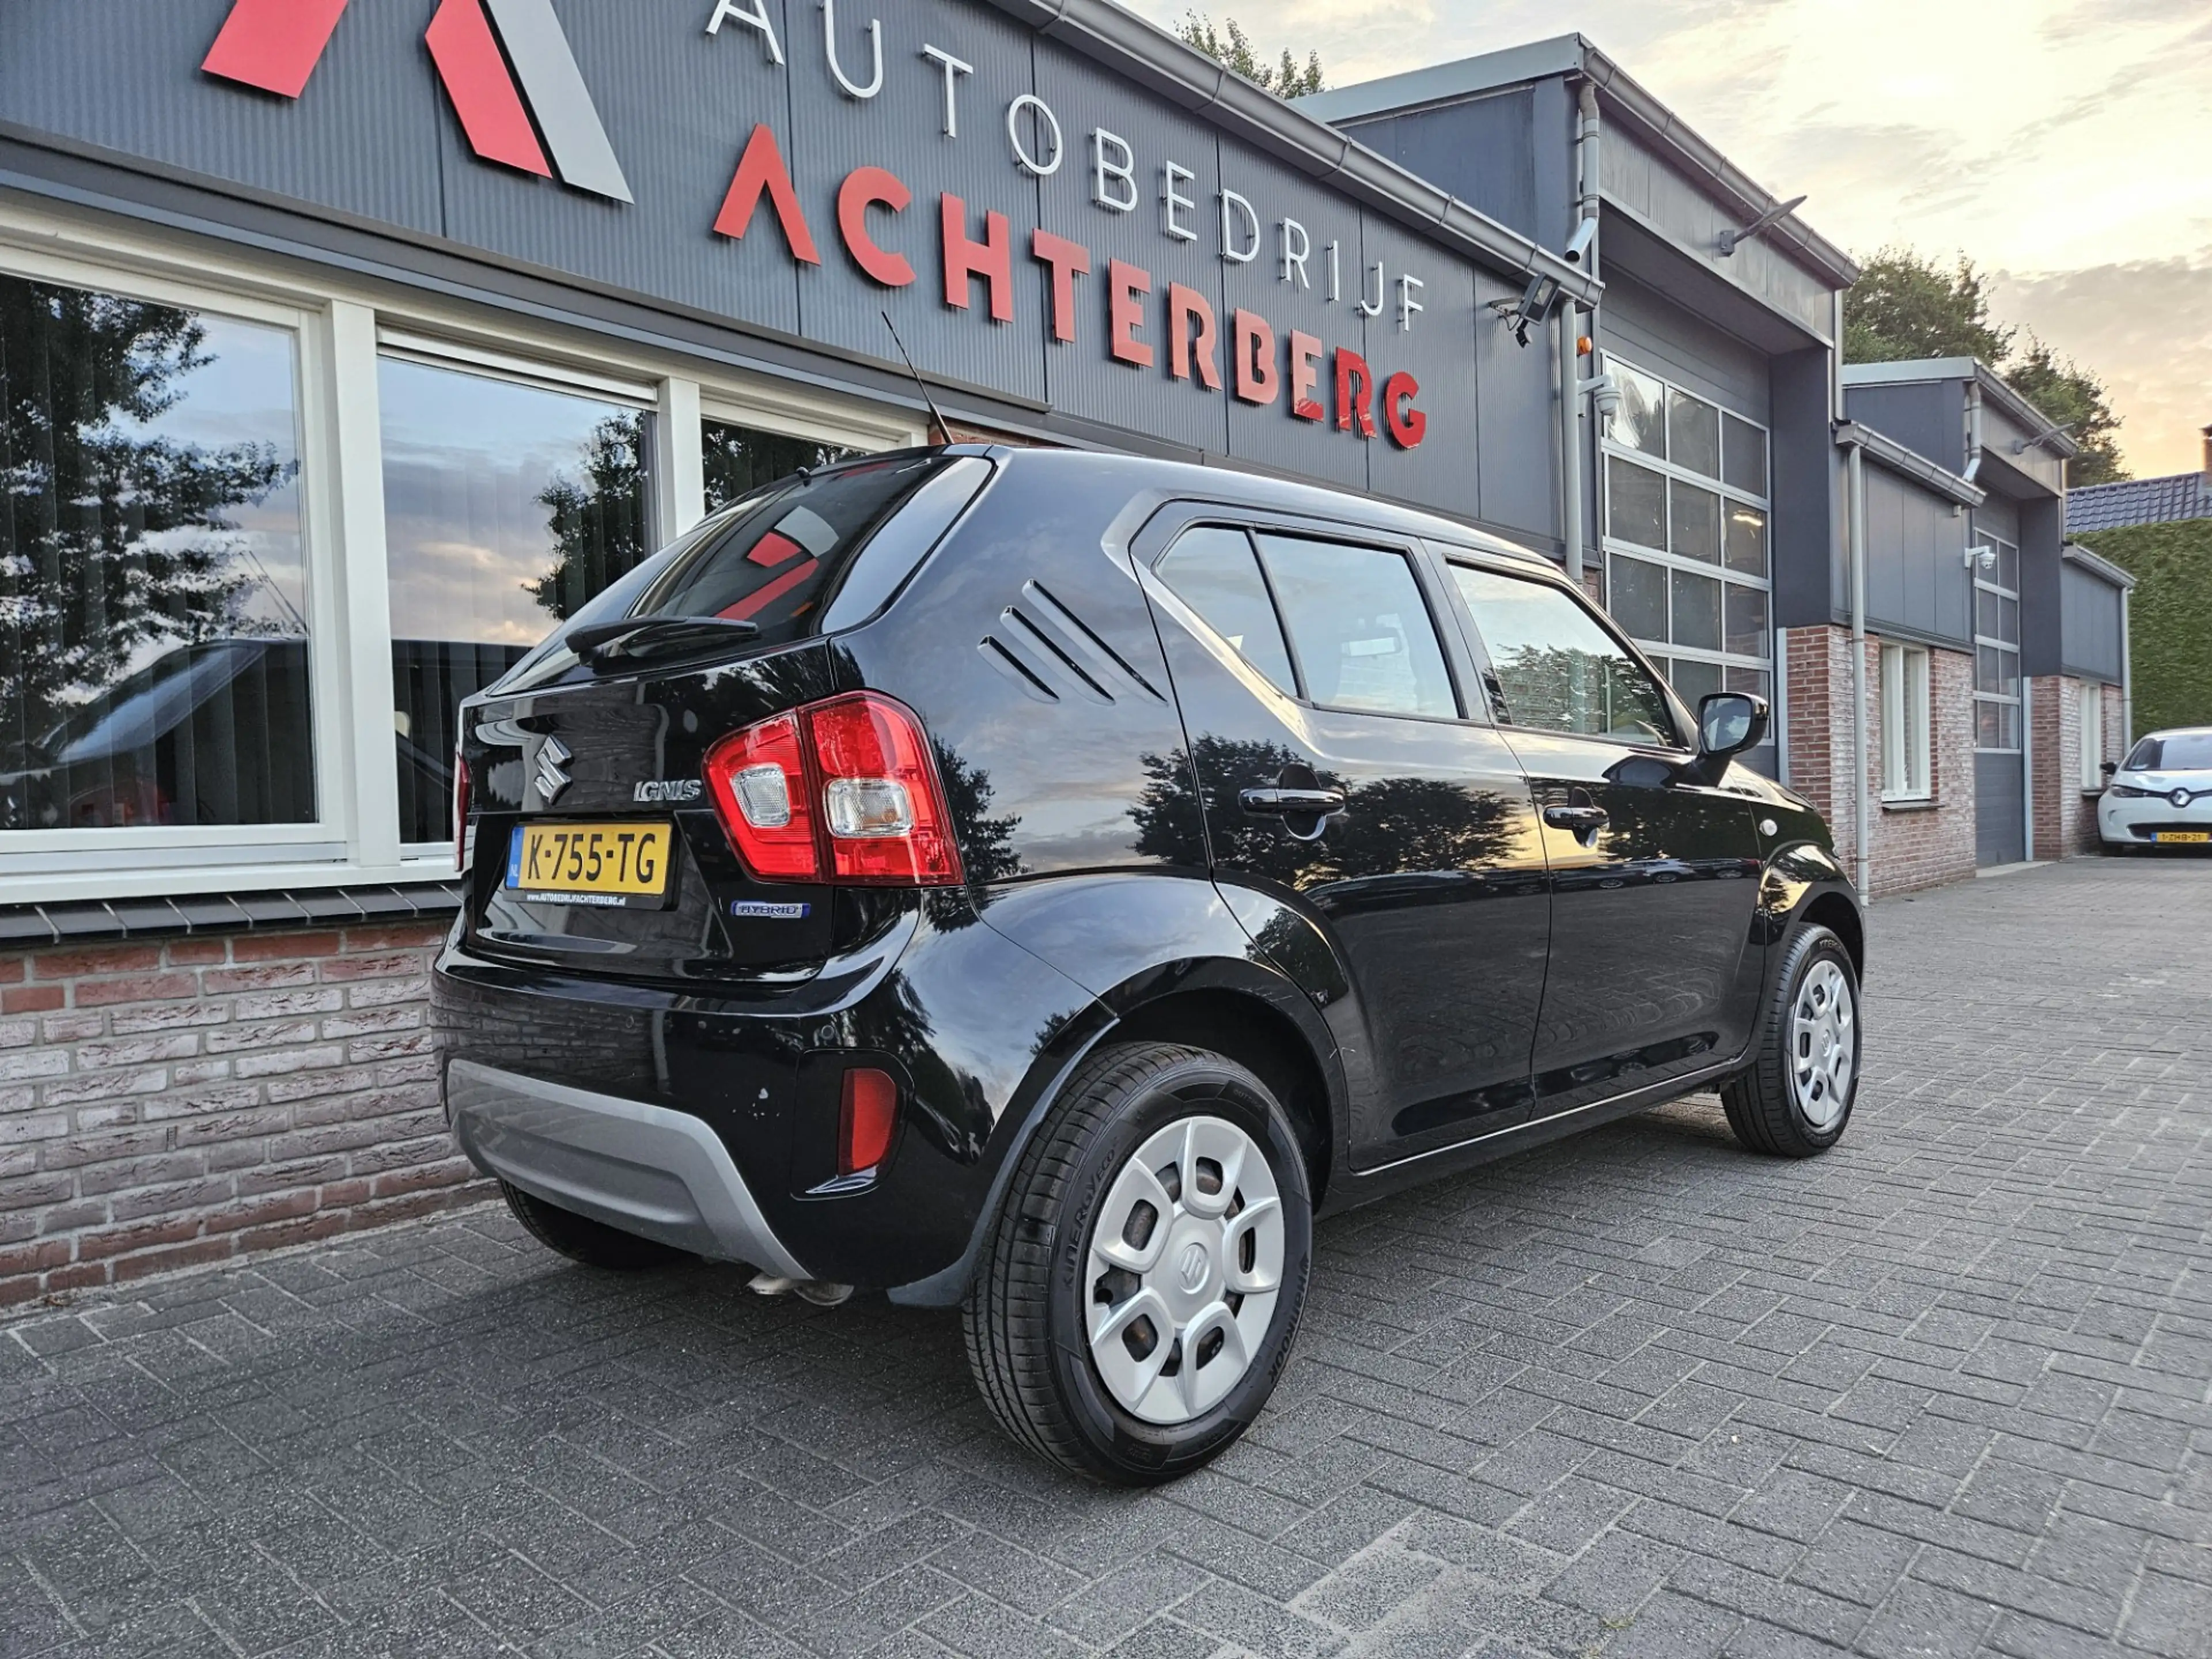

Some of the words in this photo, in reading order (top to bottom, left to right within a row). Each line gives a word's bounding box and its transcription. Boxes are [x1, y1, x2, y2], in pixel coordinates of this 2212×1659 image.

[704, 0, 1424, 331] AUTOBEDRIJF
[713, 123, 1427, 449] ACHTERBERG
[633, 779, 703, 802] IGNIS
[528, 832, 656, 884] K-755-TG
[741, 904, 797, 916] HYBRID
